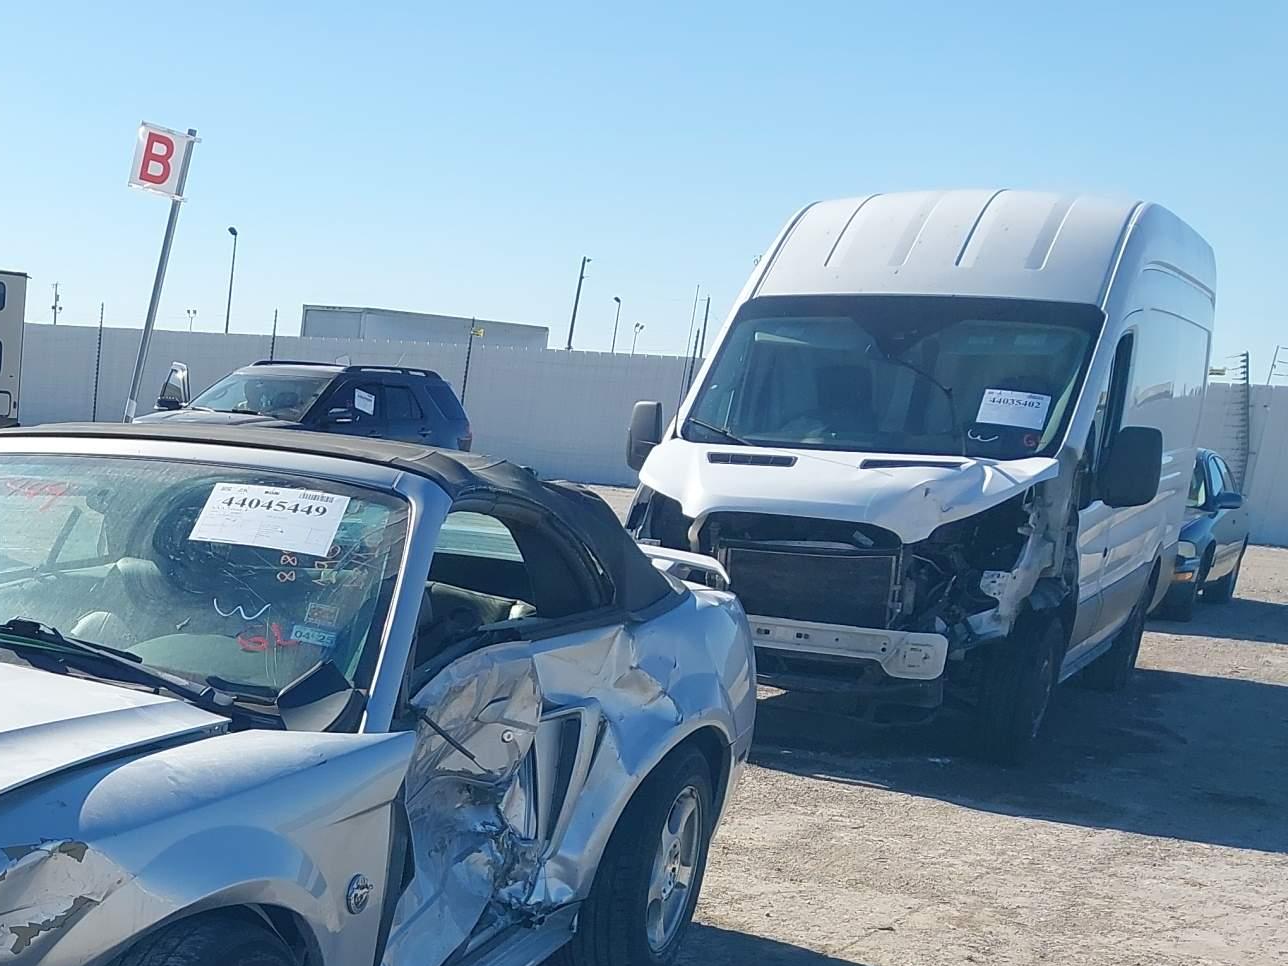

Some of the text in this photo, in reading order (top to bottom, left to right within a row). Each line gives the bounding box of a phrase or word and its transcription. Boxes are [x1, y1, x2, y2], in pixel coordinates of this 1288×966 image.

[139, 132, 174, 185] B
[989, 397, 1041, 408] 44035402
[221, 496, 327, 517] 44045449
